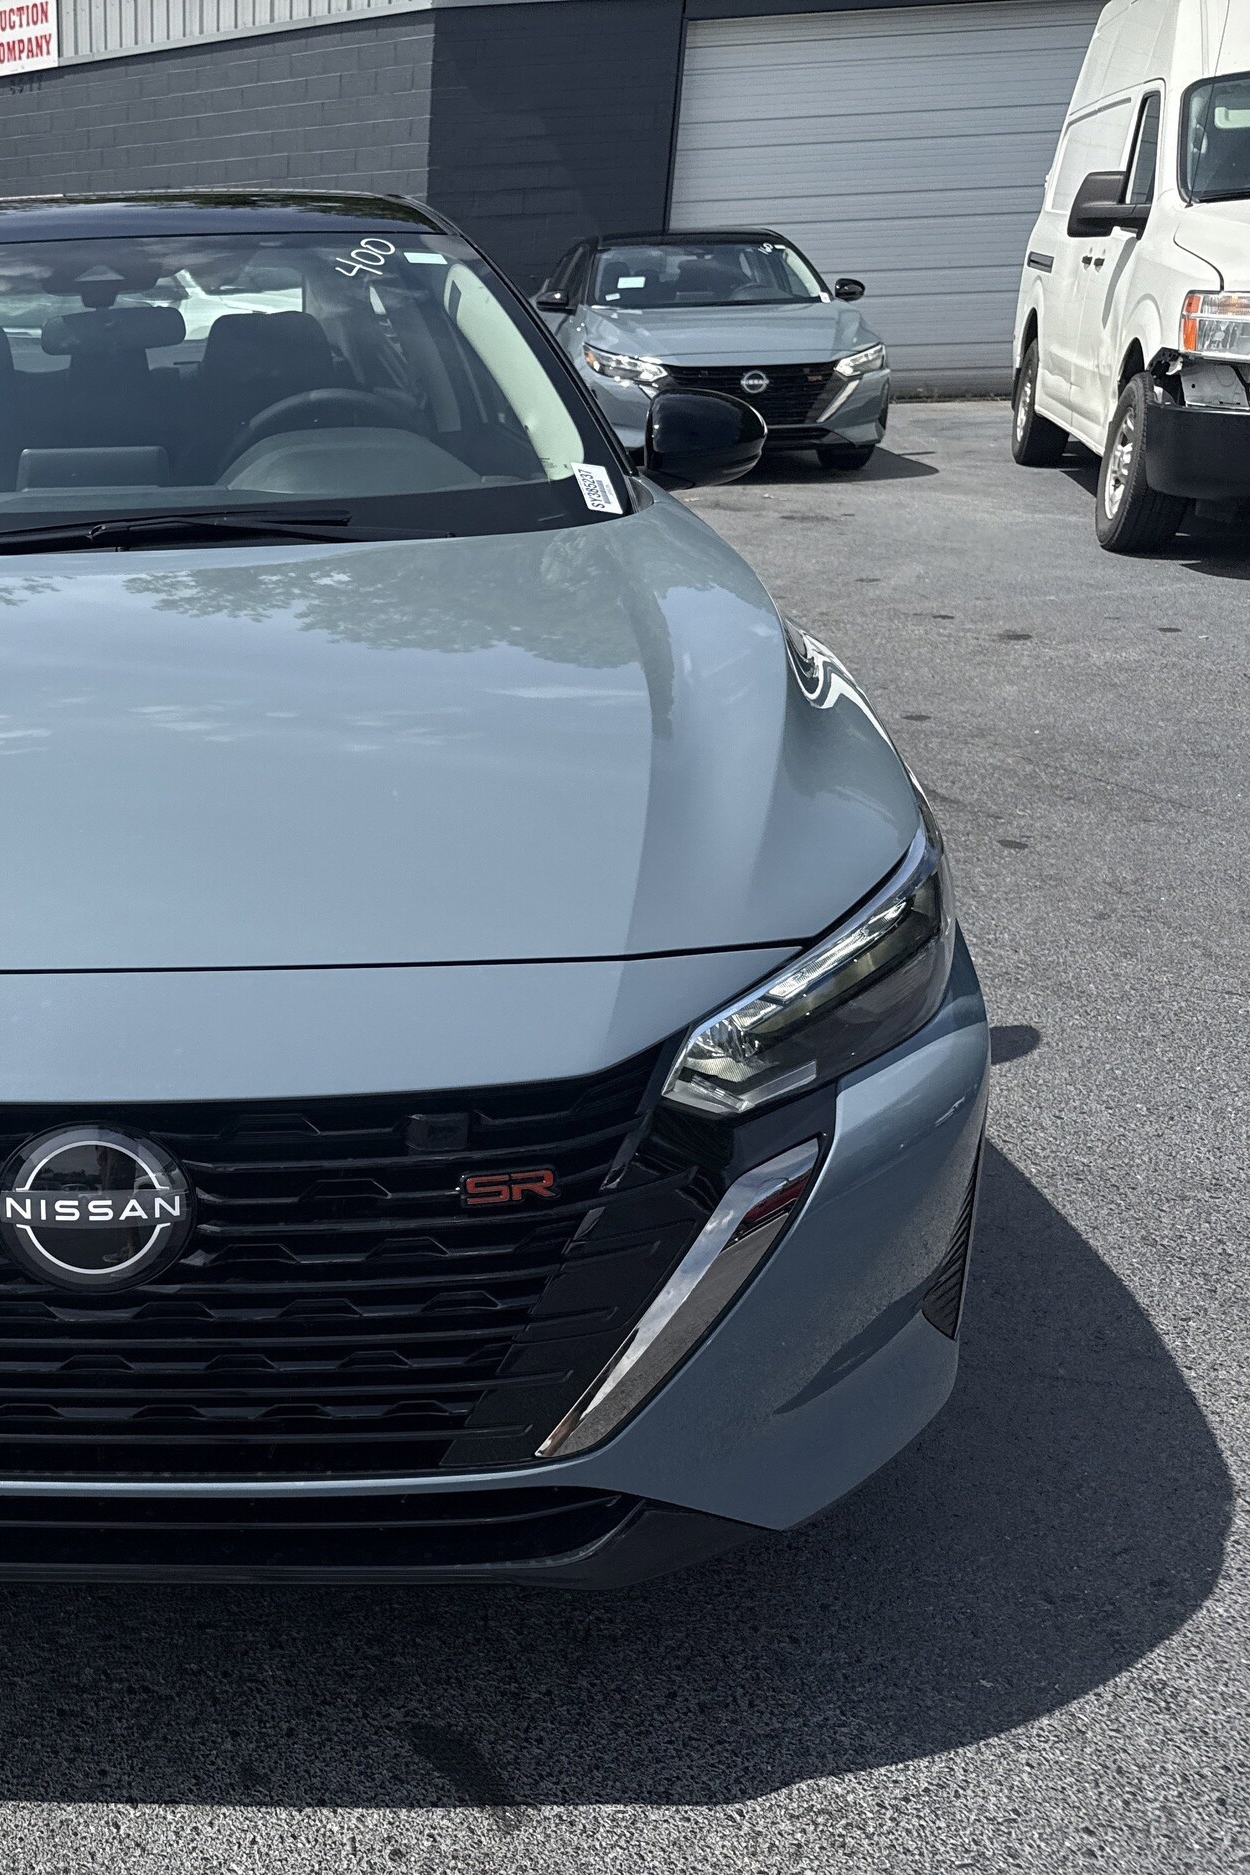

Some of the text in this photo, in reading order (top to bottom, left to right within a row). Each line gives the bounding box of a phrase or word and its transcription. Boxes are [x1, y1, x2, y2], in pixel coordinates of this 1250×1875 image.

[335, 238, 395, 277] 400
[577, 468, 606, 509] SY385237
[466, 1169, 556, 1205] SR
[6, 1195, 181, 1221] NISSAN
